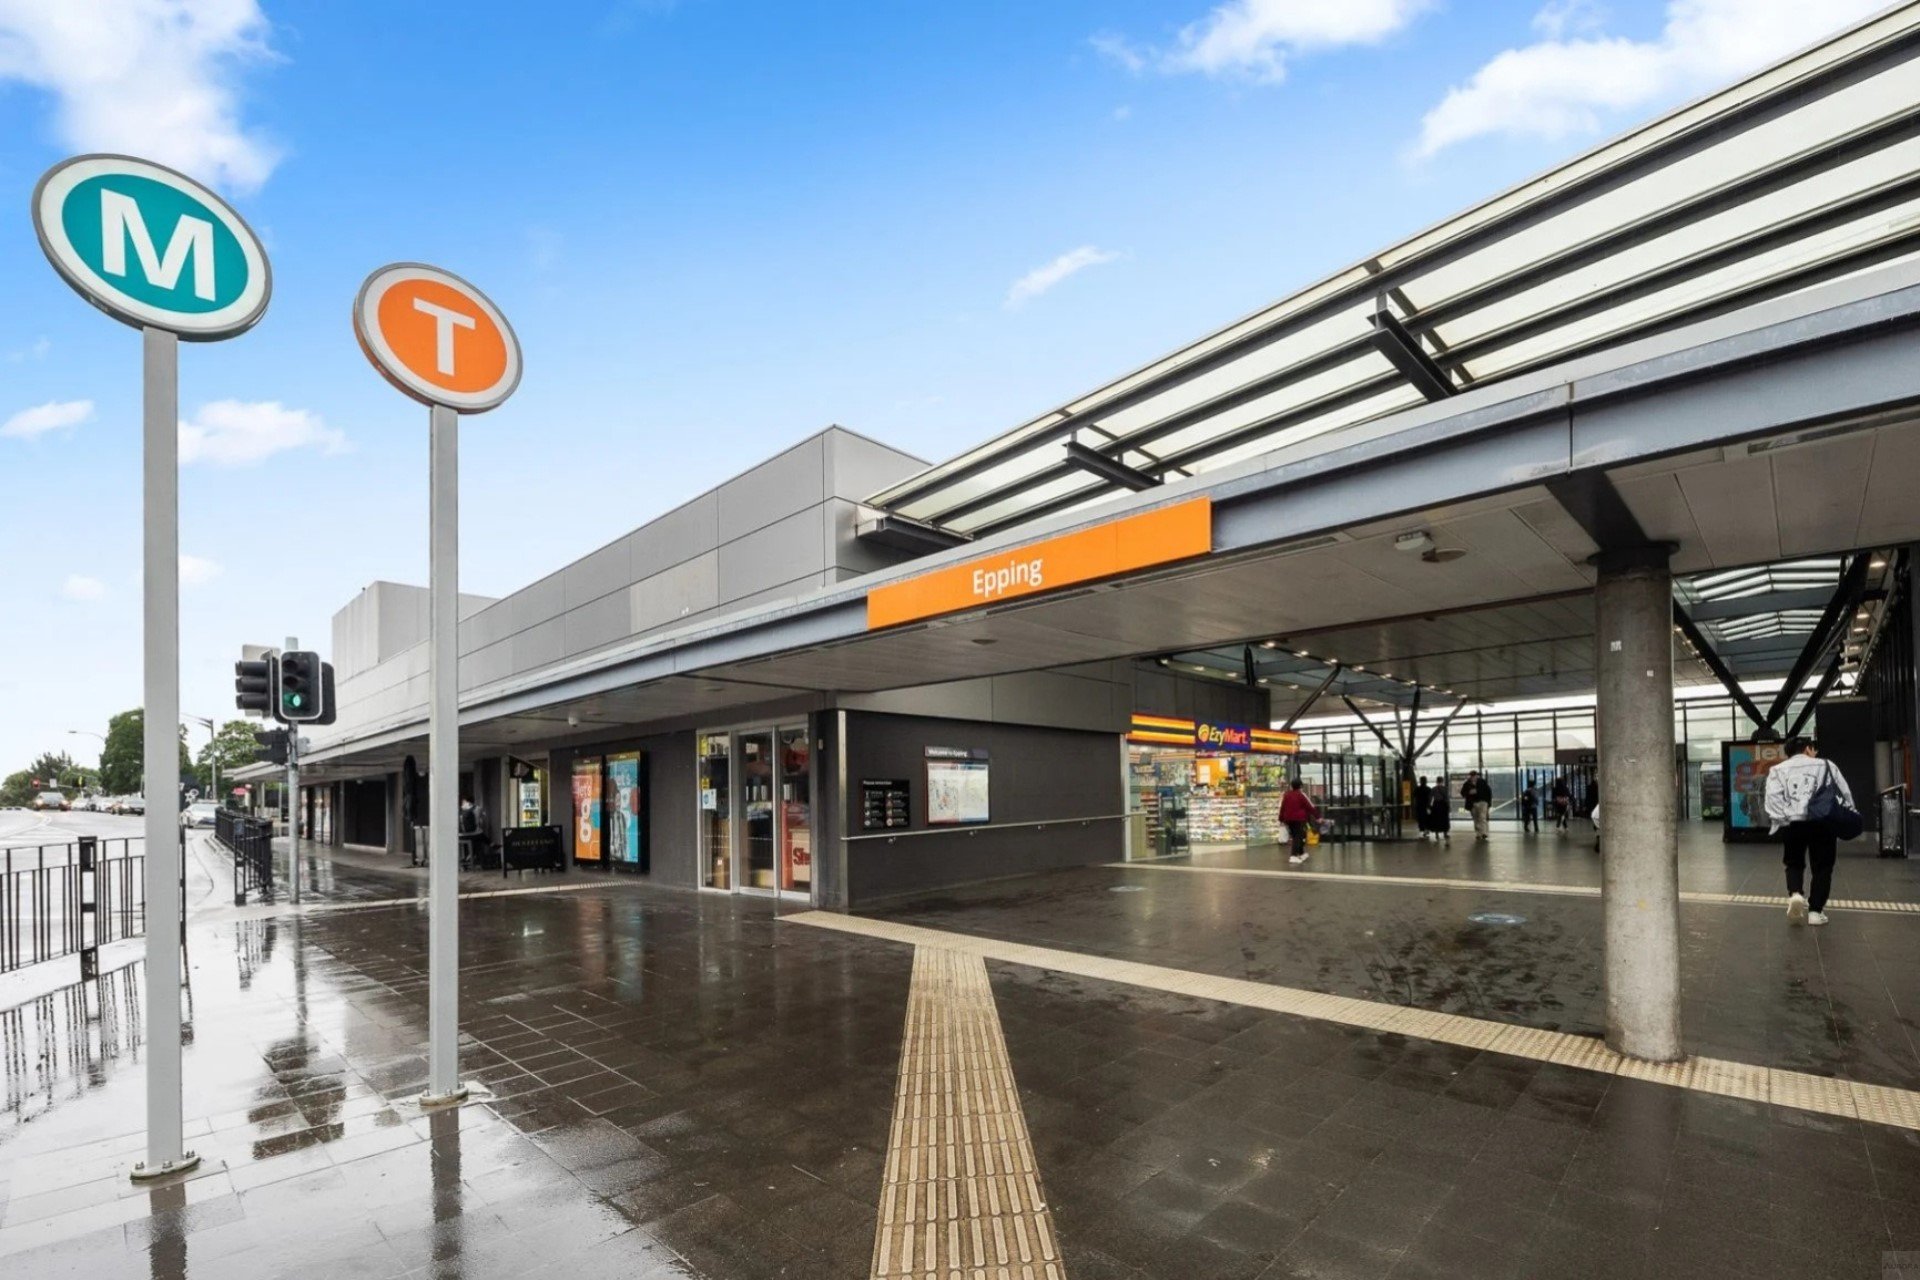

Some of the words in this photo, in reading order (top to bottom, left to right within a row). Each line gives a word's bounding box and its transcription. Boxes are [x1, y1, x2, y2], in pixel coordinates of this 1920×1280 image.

[101, 188, 215, 302] M
[413, 297, 476, 376] T
[973, 559, 1043, 598] Epping
